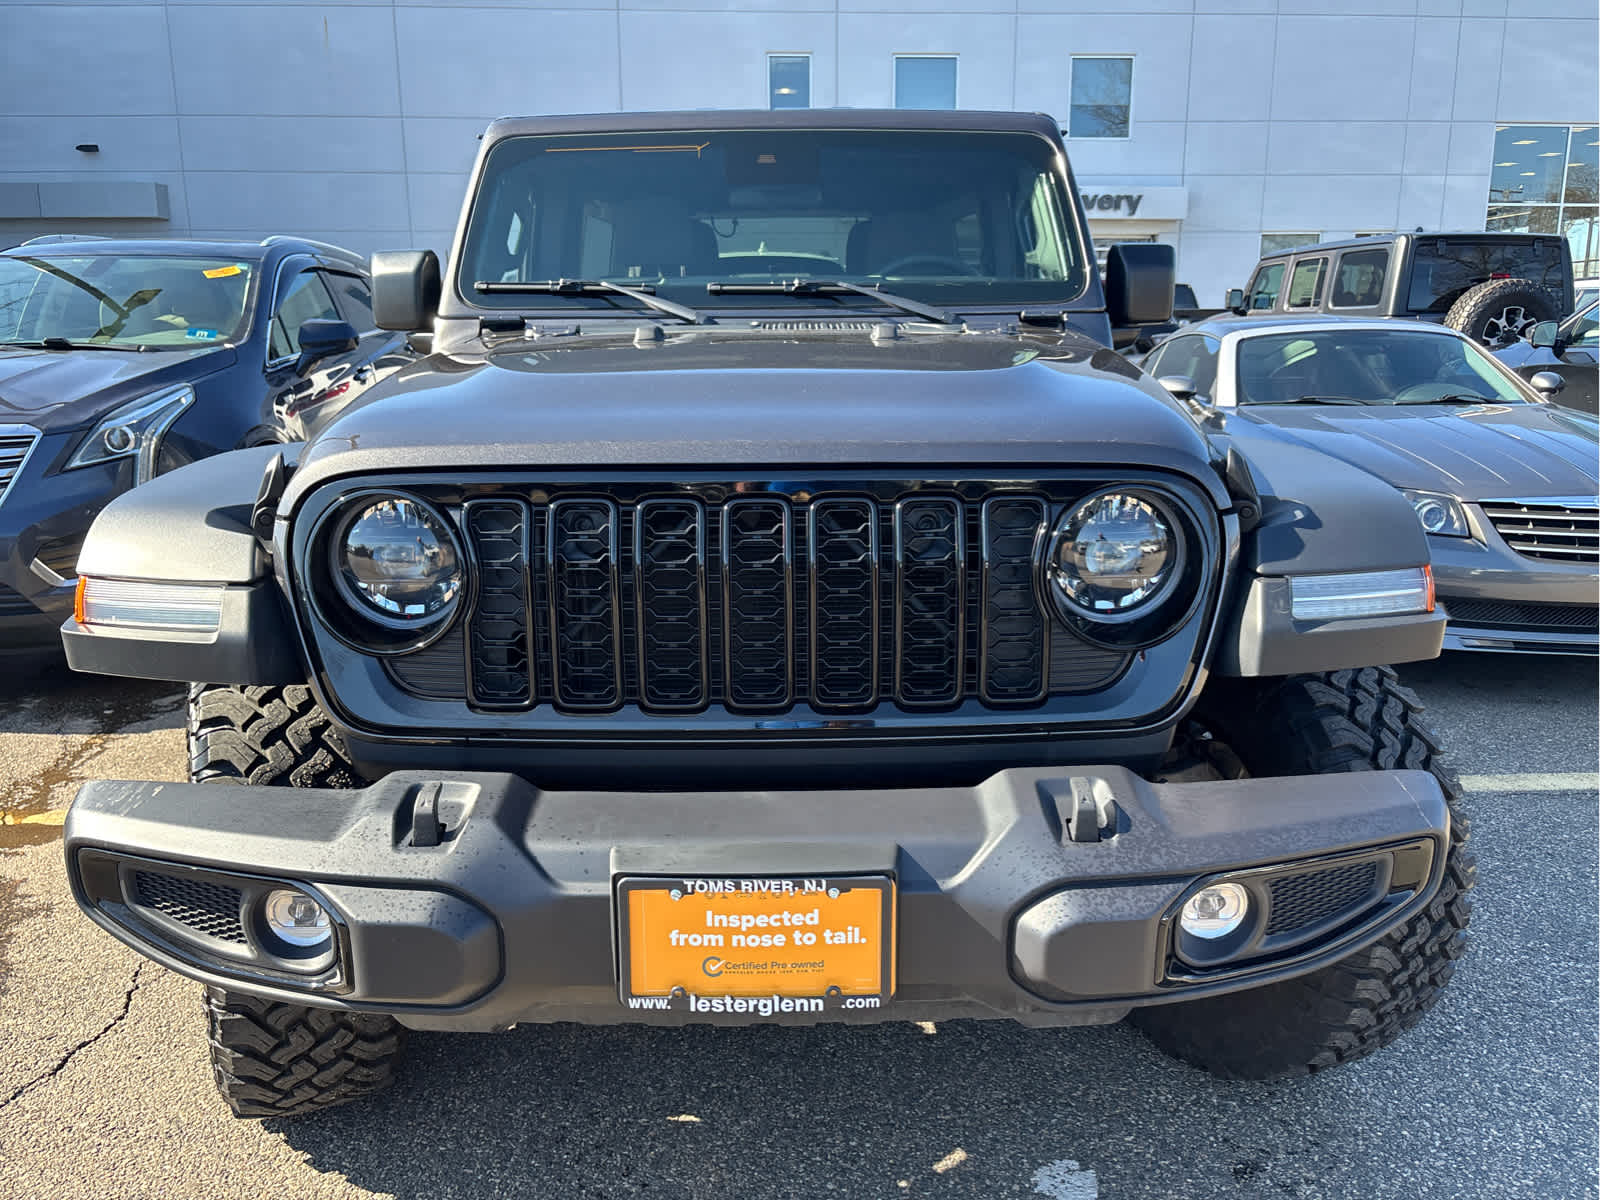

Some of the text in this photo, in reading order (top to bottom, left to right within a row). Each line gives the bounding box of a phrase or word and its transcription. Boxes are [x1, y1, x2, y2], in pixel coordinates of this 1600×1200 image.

[1079, 191, 1143, 216] very
[684, 880, 736, 893] TOMS
[804, 879, 827, 892] NJ
[706, 909, 819, 931] Inspected
[669, 926, 867, 947] from nose to tail.
[725, 961, 768, 970] Certified
[628, 995, 880, 1016] www. lesterglenn .com
